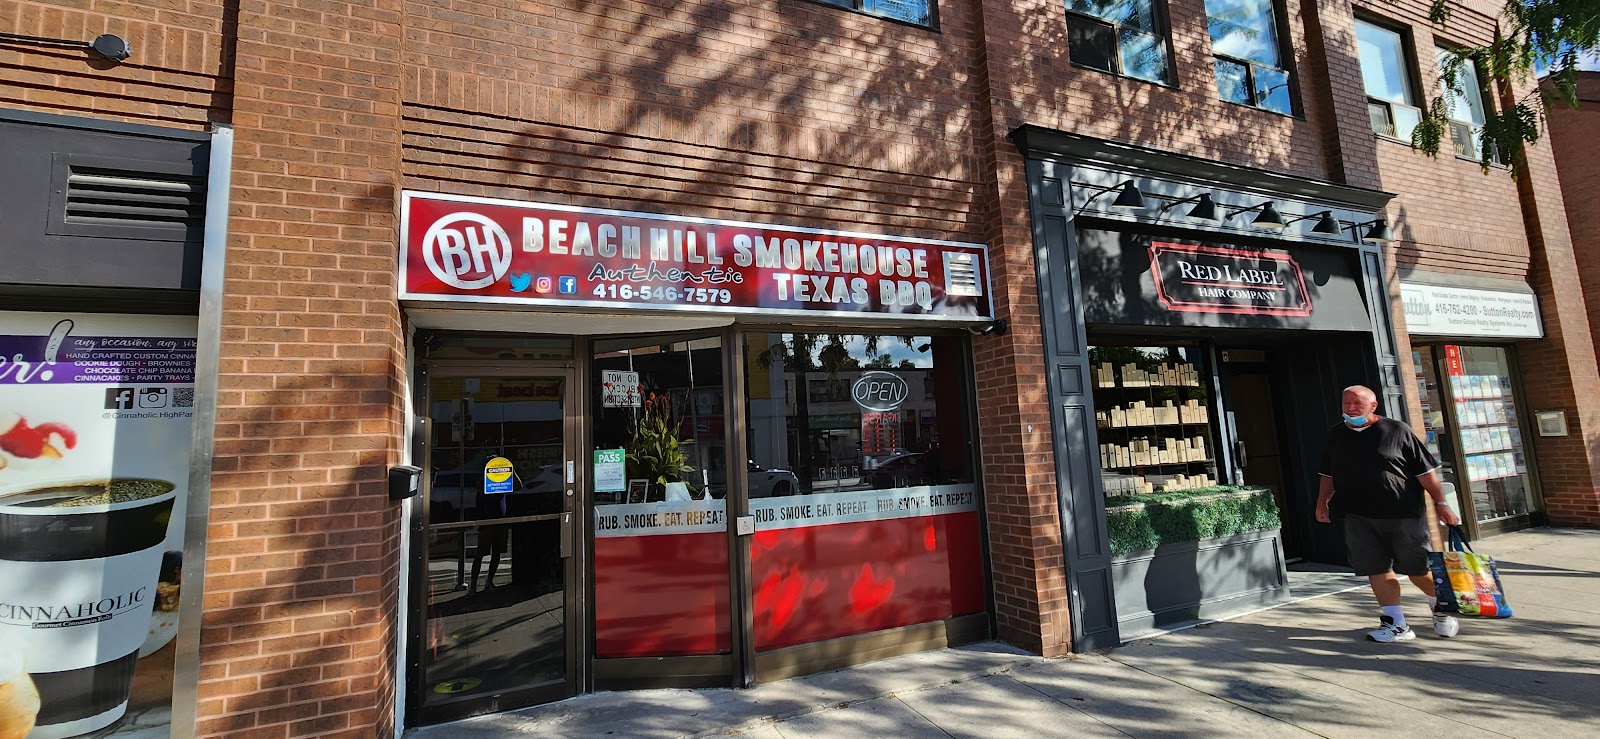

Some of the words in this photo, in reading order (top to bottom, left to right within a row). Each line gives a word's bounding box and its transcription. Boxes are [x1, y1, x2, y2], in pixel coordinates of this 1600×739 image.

[522, 217, 641, 260] BEACH
[650, 227, 724, 265] HILL
[732, 234, 929, 279] SMOKEHOUSE
[588, 261, 744, 283] Authentic
[1176, 260, 1222, 281] RED
[1223, 264, 1284, 286] LABEL
[592, 283, 732, 304] 416-546-7579
[772, 272, 870, 305] TEXAS
[878, 279, 933, 310] BBQ
[1197, 287, 1226, 298] HAIR
[1226, 289, 1276, 301] COMPANY
[1435, 302, 1477, 316] 416-762-4200
[1483, 305, 1535, 320] SuttonRealty.com
[1463, 318, 1476, 326] Group
[1477, 319, 1489, 327] Realty
[1490, 319, 1506, 327] Systems
[74, 339, 97, 352] any
[157, 339, 178, 352] any
[855, 381, 903, 401] OPEN
[598, 453, 621, 463] PASS
[755, 509, 778, 523] RUB.
[780, 504, 814, 520] SMOKE.
[816, 503, 834, 517] EAT.
[836, 500, 868, 516] REPEAT
[877, 498, 897, 512] RUB.
[898, 494, 928, 510] SMOKE.
[929, 494, 945, 507] EAT.
[946, 492, 973, 506] REPEAT
[598, 514, 621, 530] RUB.
[624, 512, 661, 529] SMOKE.
[664, 511, 684, 527] EAT.
[686, 510, 724, 526] REPEAT
[0, 586, 147, 621] CINNAHOLIC
[32, 621, 63, 629] Gourmet
